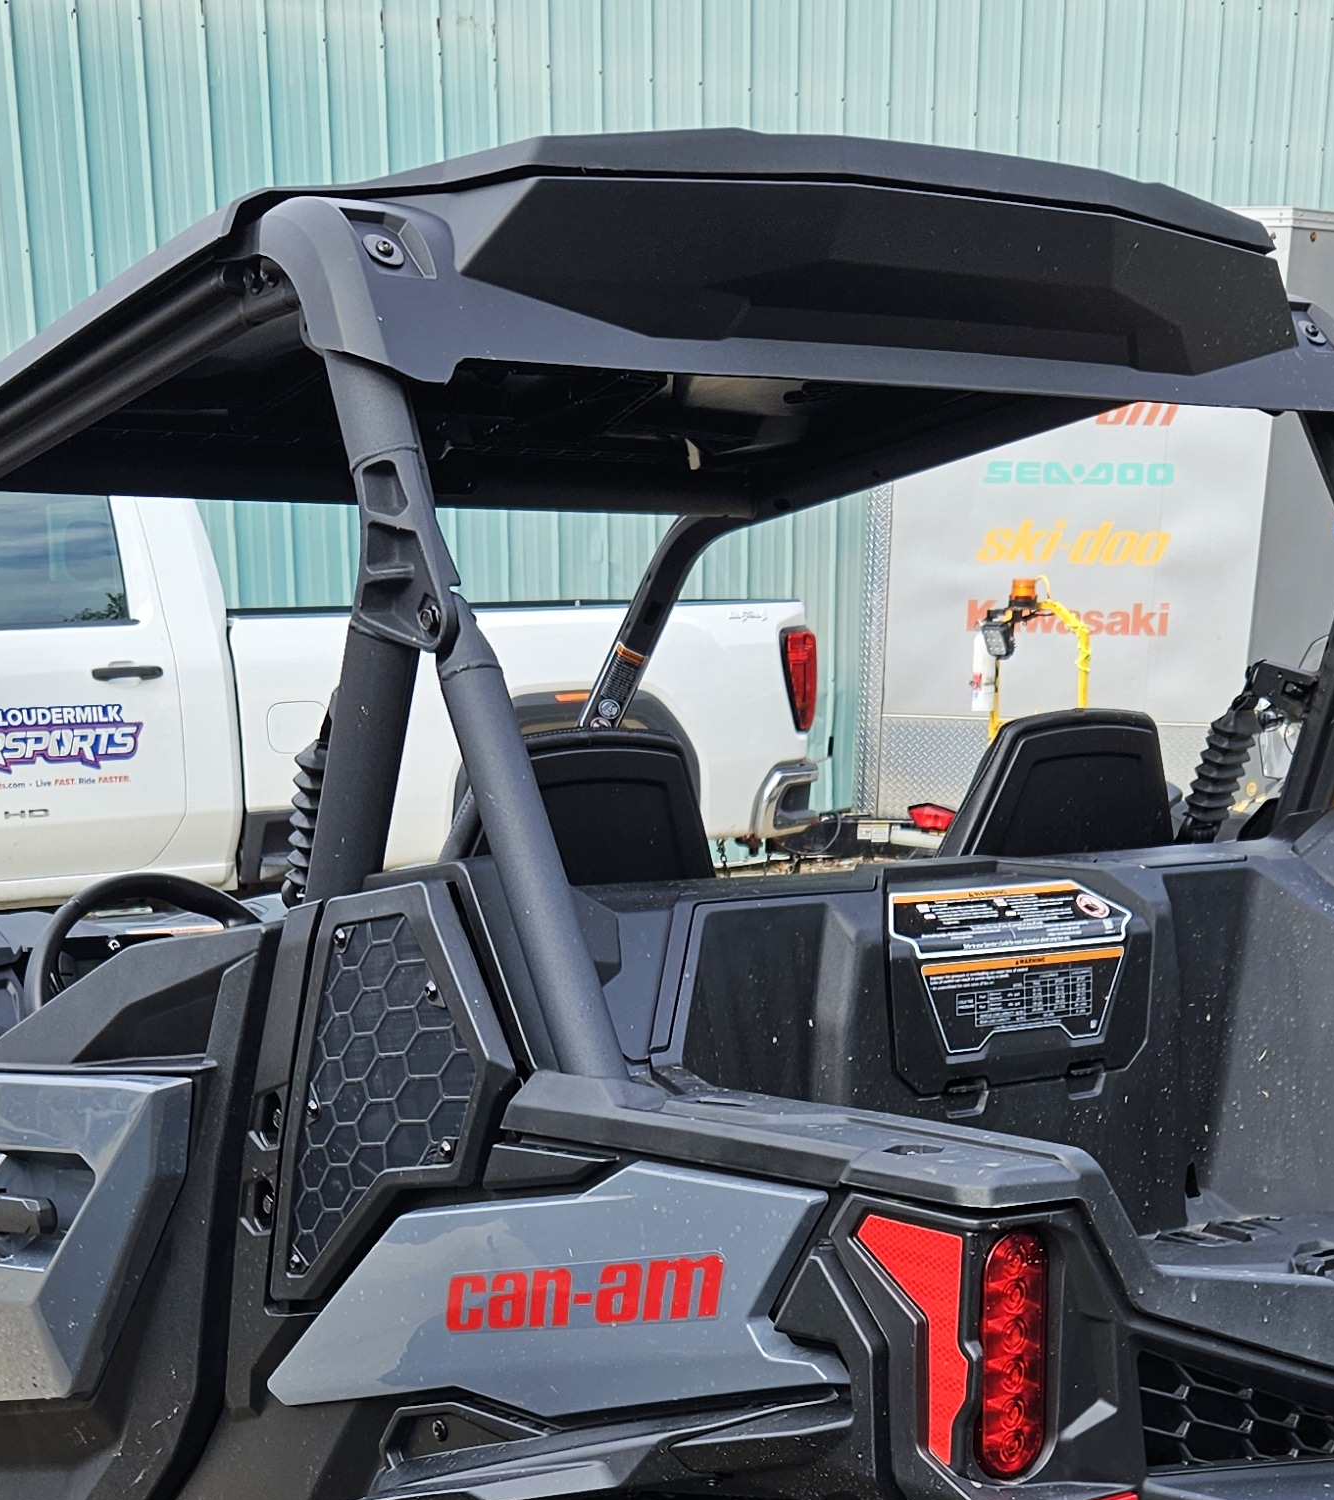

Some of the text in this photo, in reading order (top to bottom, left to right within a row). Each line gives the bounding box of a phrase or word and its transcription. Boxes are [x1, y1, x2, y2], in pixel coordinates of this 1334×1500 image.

[976, 519, 1172, 567] ski-doo
[35, 779, 52, 788] Live
[54, 778, 76, 787] FAST.
[78, 777, 96, 786] Ride
[98, 775, 132, 784] FASTER.
[4, 808, 50, 819] HD
[445, 1253, 725, 1333] can-am
